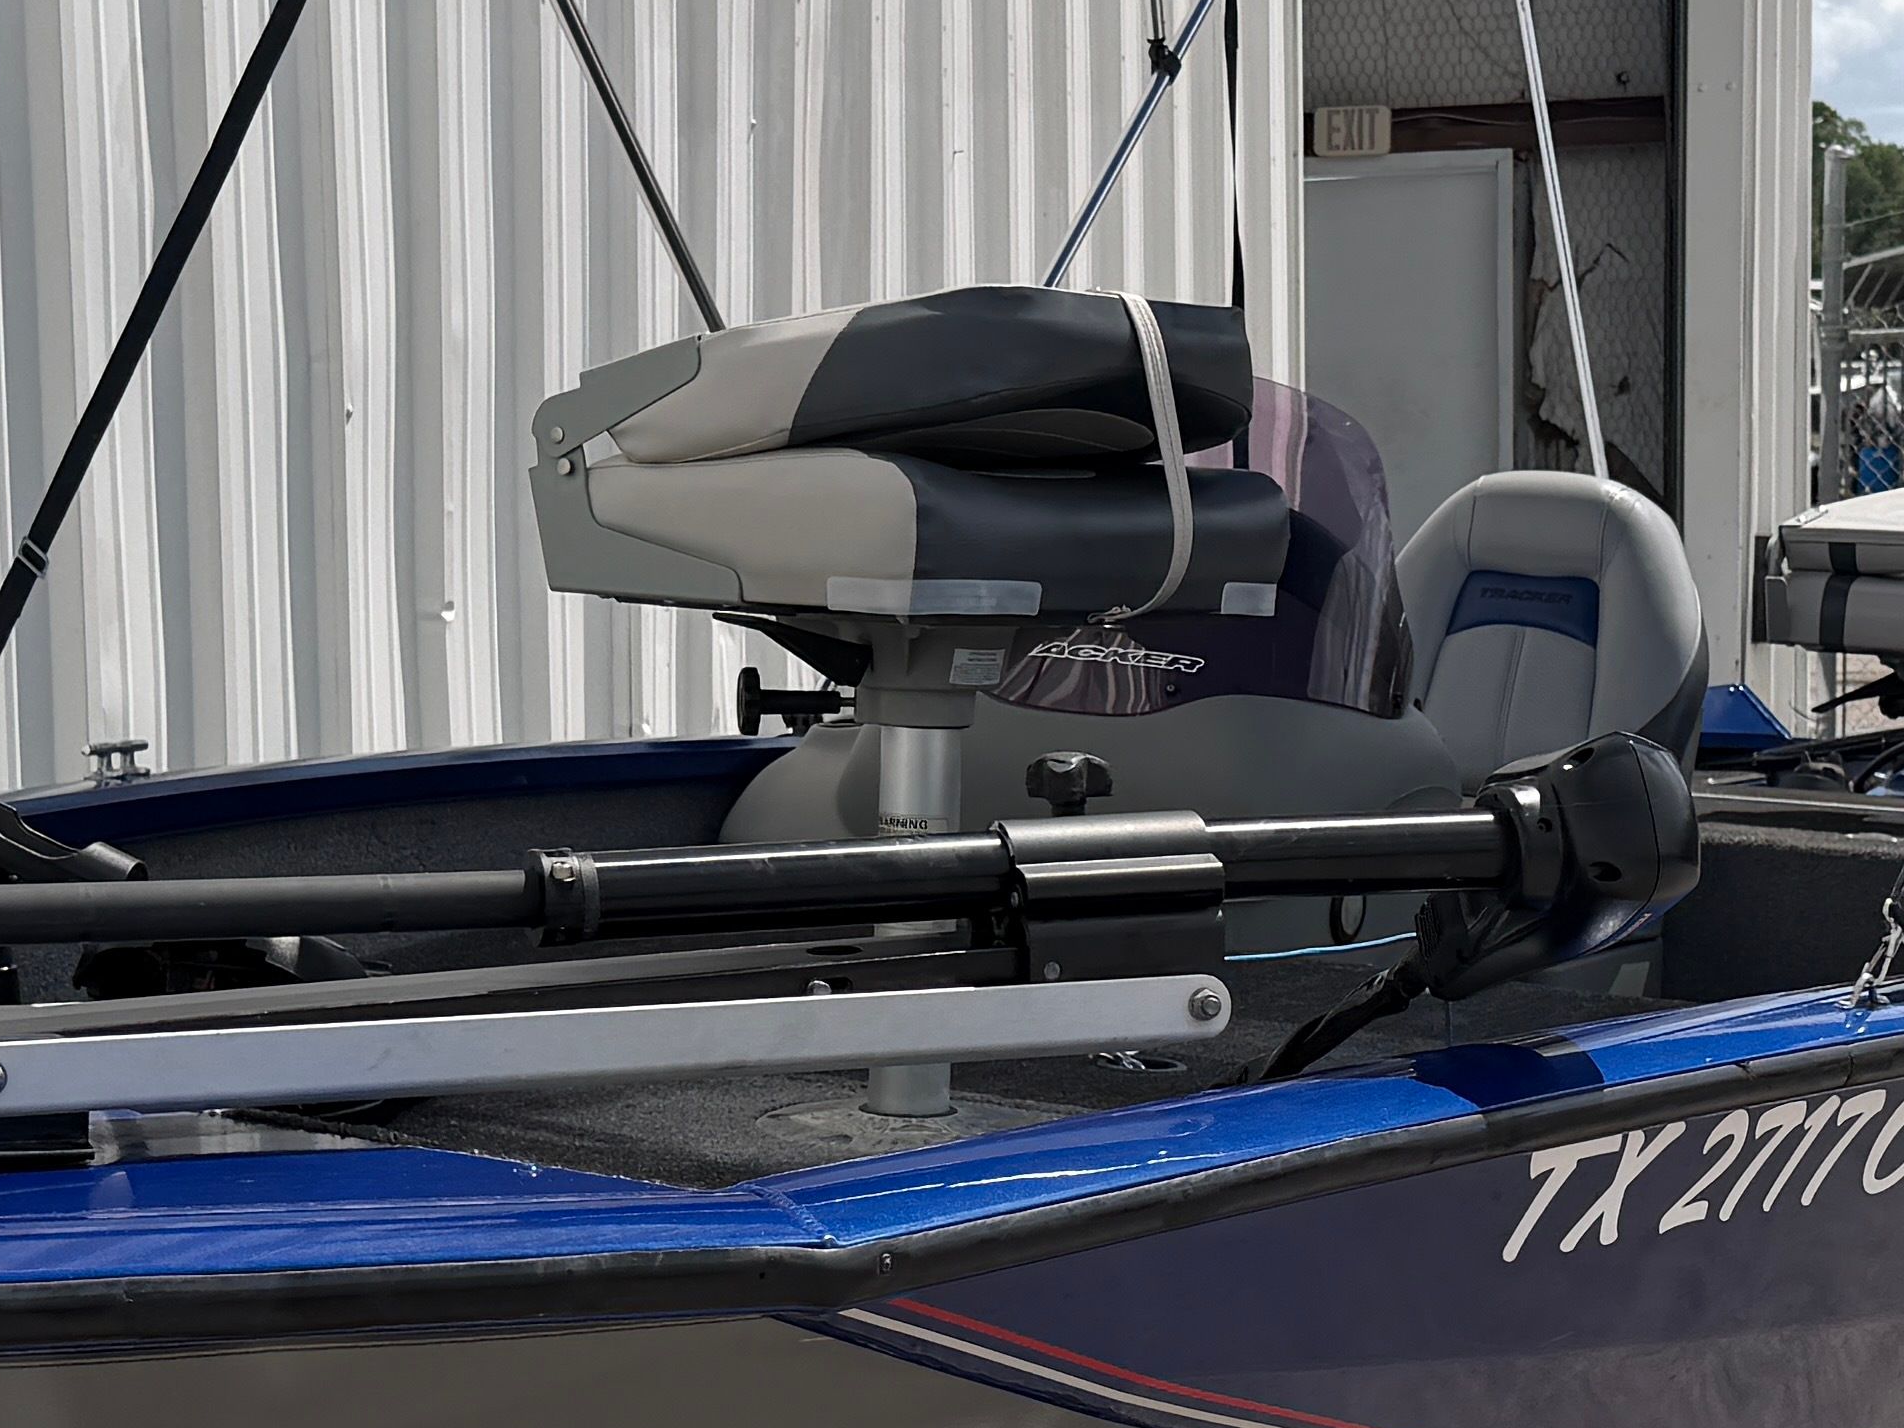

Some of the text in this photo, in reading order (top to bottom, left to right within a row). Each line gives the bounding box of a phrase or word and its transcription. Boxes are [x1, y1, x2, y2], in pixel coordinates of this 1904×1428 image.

[1325, 108, 1380, 152] EXIT
[1480, 586, 1573, 605] TRACKER
[1502, 1121, 1687, 1263] TX
